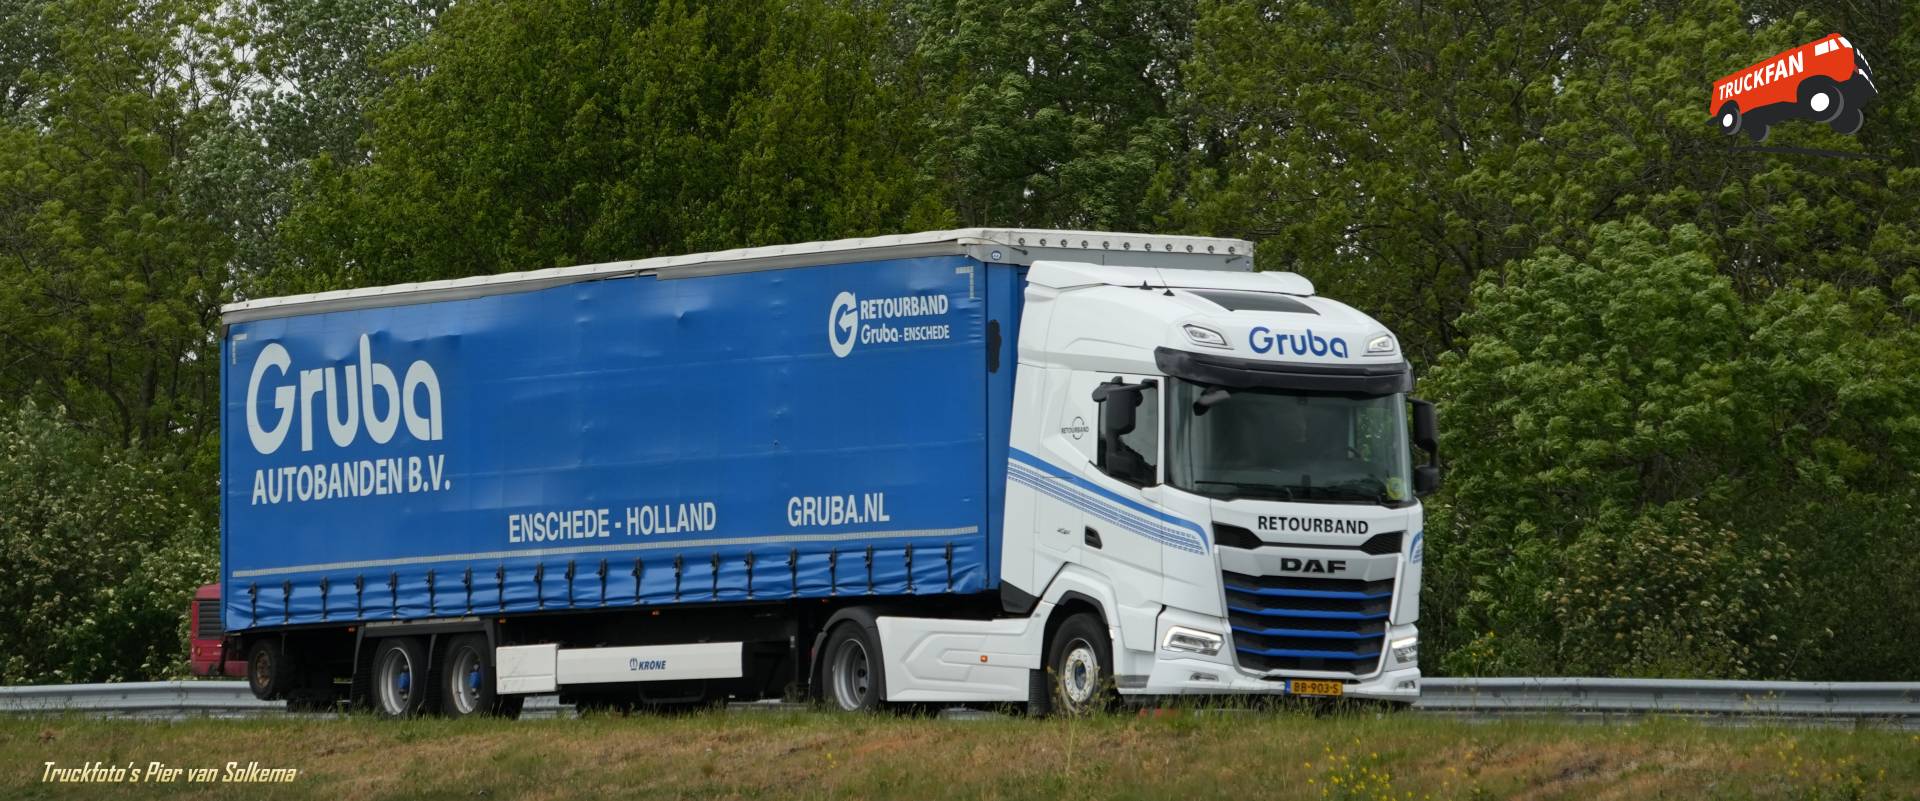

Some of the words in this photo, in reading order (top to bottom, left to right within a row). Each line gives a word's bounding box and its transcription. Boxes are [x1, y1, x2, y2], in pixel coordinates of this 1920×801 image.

[860, 294, 949, 320] RETOURBAND
[860, 323, 898, 345] Gruba
[904, 324, 950, 342] ENSCHEDE
[1249, 326, 1349, 358] Gruba
[246, 333, 443, 455] Gruba
[1061, 426, 1089, 434] RETOURBAND
[251, 456, 402, 506] AUTOBANDEN
[408, 454, 451, 493] B.V.
[508, 508, 610, 543] ENSCHEDE
[626, 501, 717, 536] HOLLAND
[787, 492, 890, 527] GRUBA.NL
[1258, 515, 1369, 535] RETOURBAND
[1280, 557, 1346, 574] DAF
[639, 660, 667, 670] KRONE
